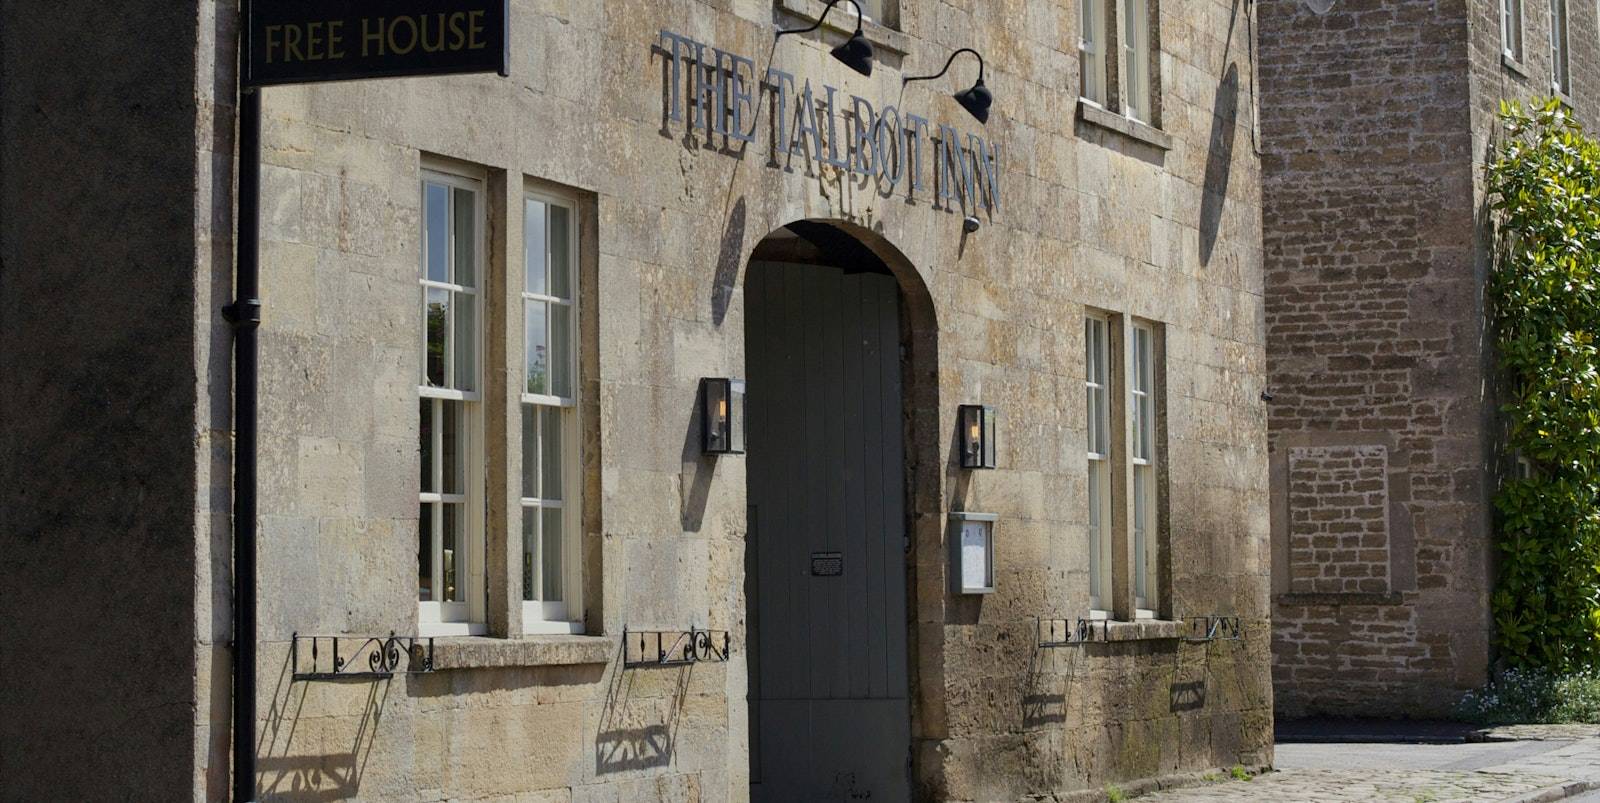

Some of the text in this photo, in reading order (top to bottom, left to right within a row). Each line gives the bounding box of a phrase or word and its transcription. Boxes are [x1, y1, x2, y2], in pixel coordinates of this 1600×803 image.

[265, 10, 486, 63] FREE HOUSE
[661, 29, 1001, 213] THE TALBOT INN
